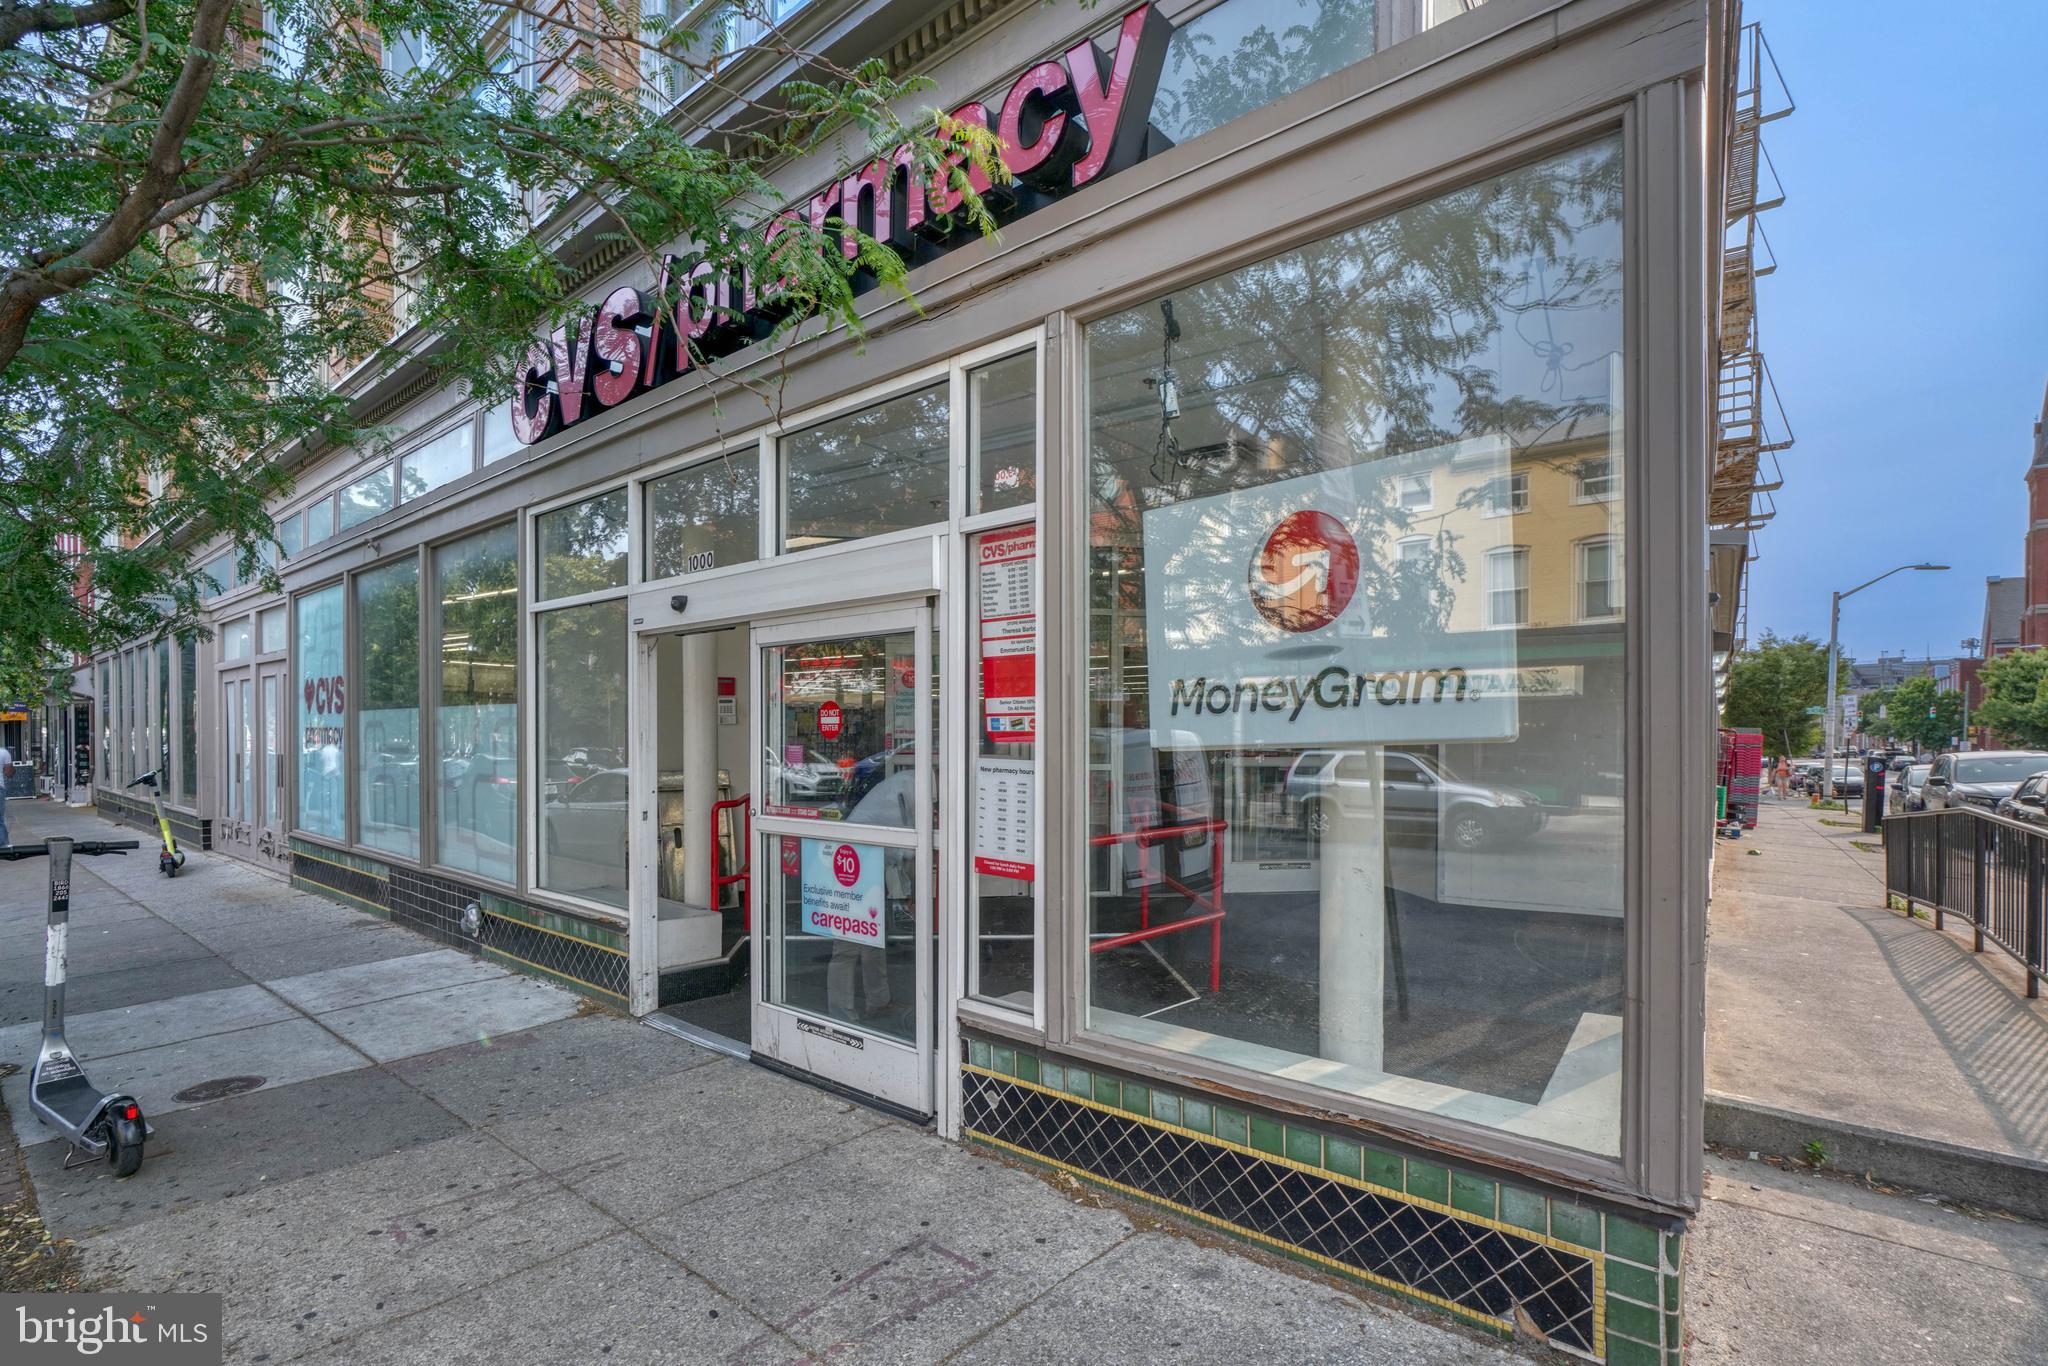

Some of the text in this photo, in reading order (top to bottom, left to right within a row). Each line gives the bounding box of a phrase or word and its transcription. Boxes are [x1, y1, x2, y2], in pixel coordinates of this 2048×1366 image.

[688, 552, 713, 571] 1000
[316, 676, 344, 715] CVS
[1170, 664, 1467, 723] MoneyGram
[820, 709, 839, 717] DO NOT
[992, 766, 1019, 776] pharmacy
[837, 854, 855, 873] $10
[803, 883, 864, 903] Exclusive member
[803, 896, 849, 912] benefits await!
[811, 911, 878, 937] carepass
